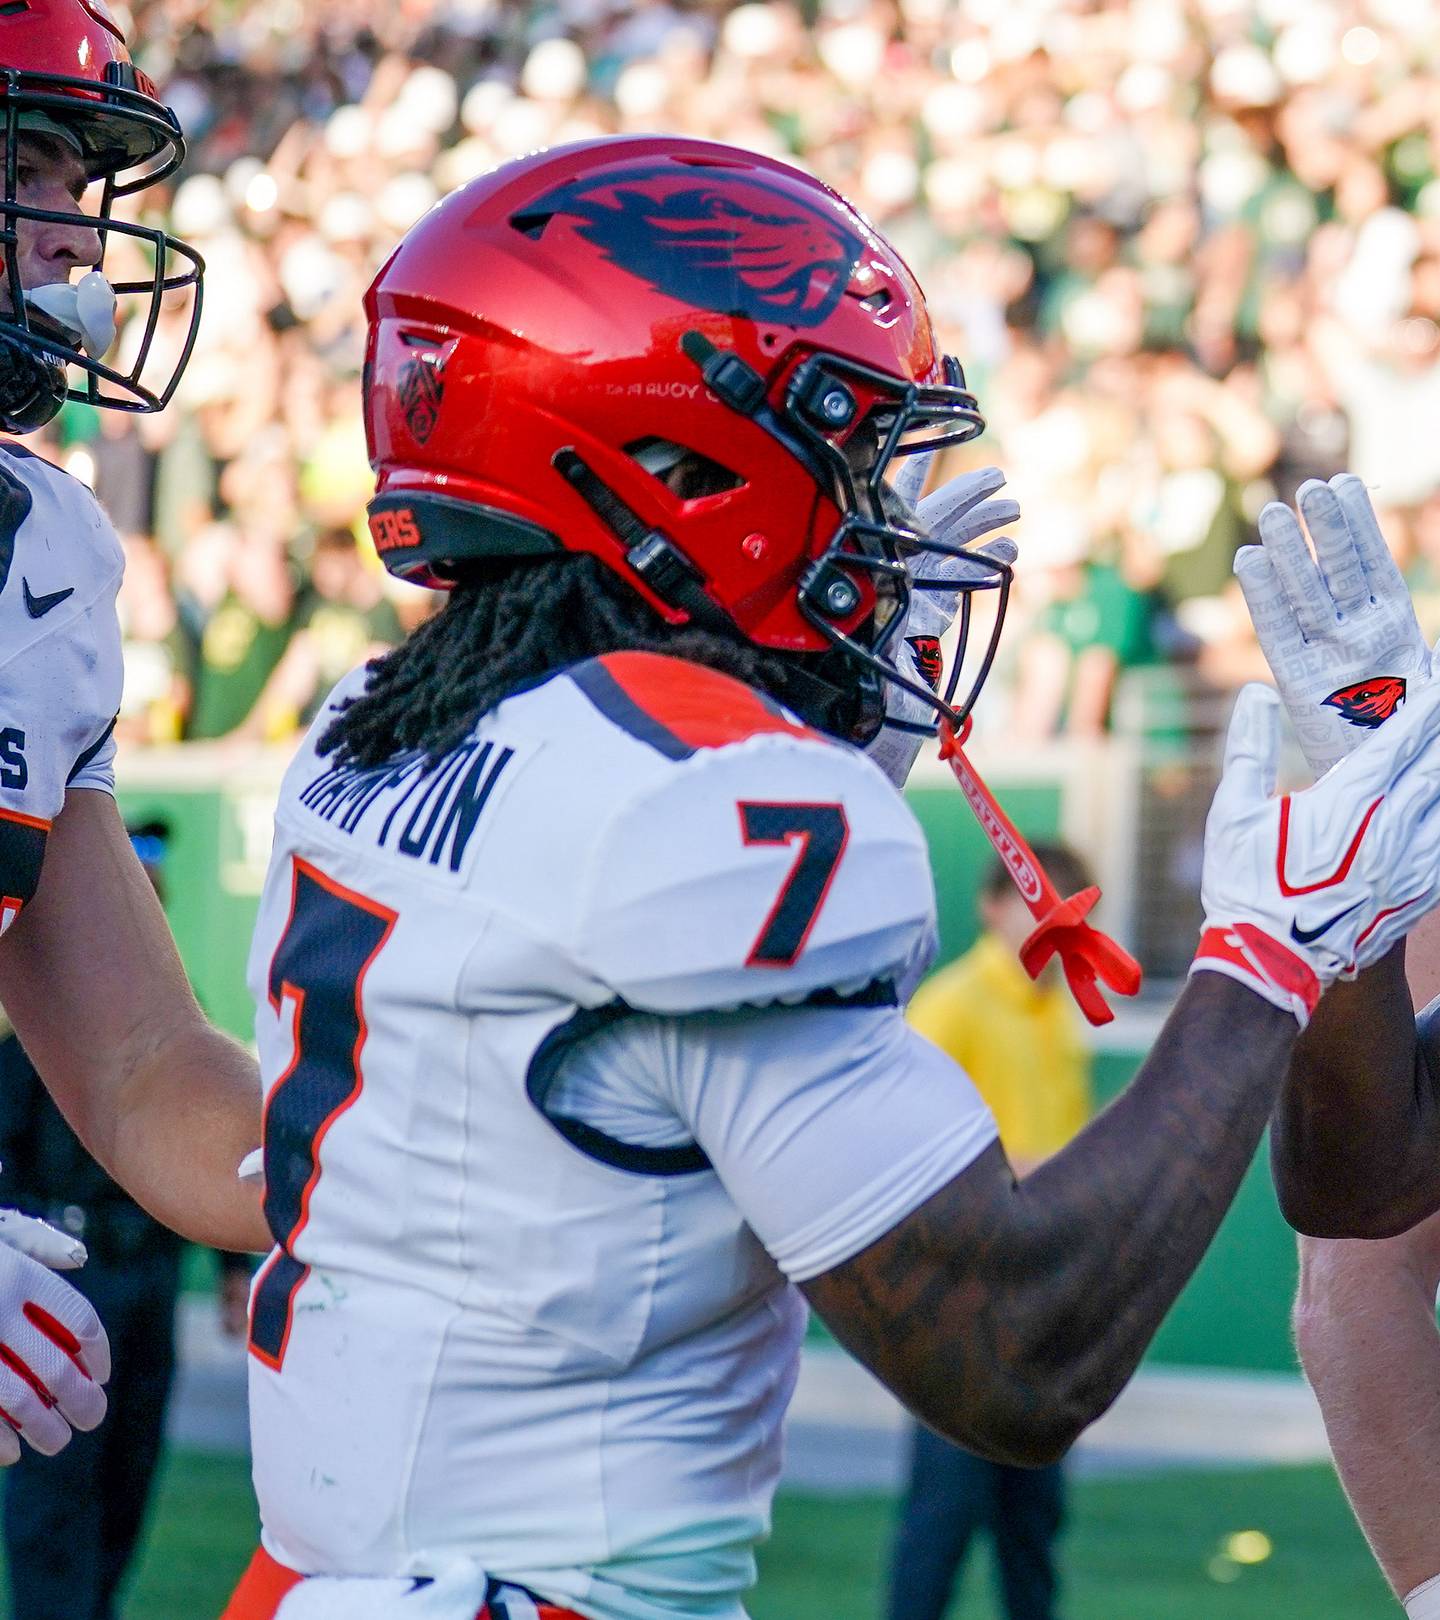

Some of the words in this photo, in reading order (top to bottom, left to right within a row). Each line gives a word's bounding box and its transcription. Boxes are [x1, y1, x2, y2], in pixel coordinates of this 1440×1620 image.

[1287, 625, 1401, 683] BEAVERS
[737, 800, 850, 971] 7
[956, 768, 1037, 892] BATTLE
[248, 856, 399, 1373] 7
